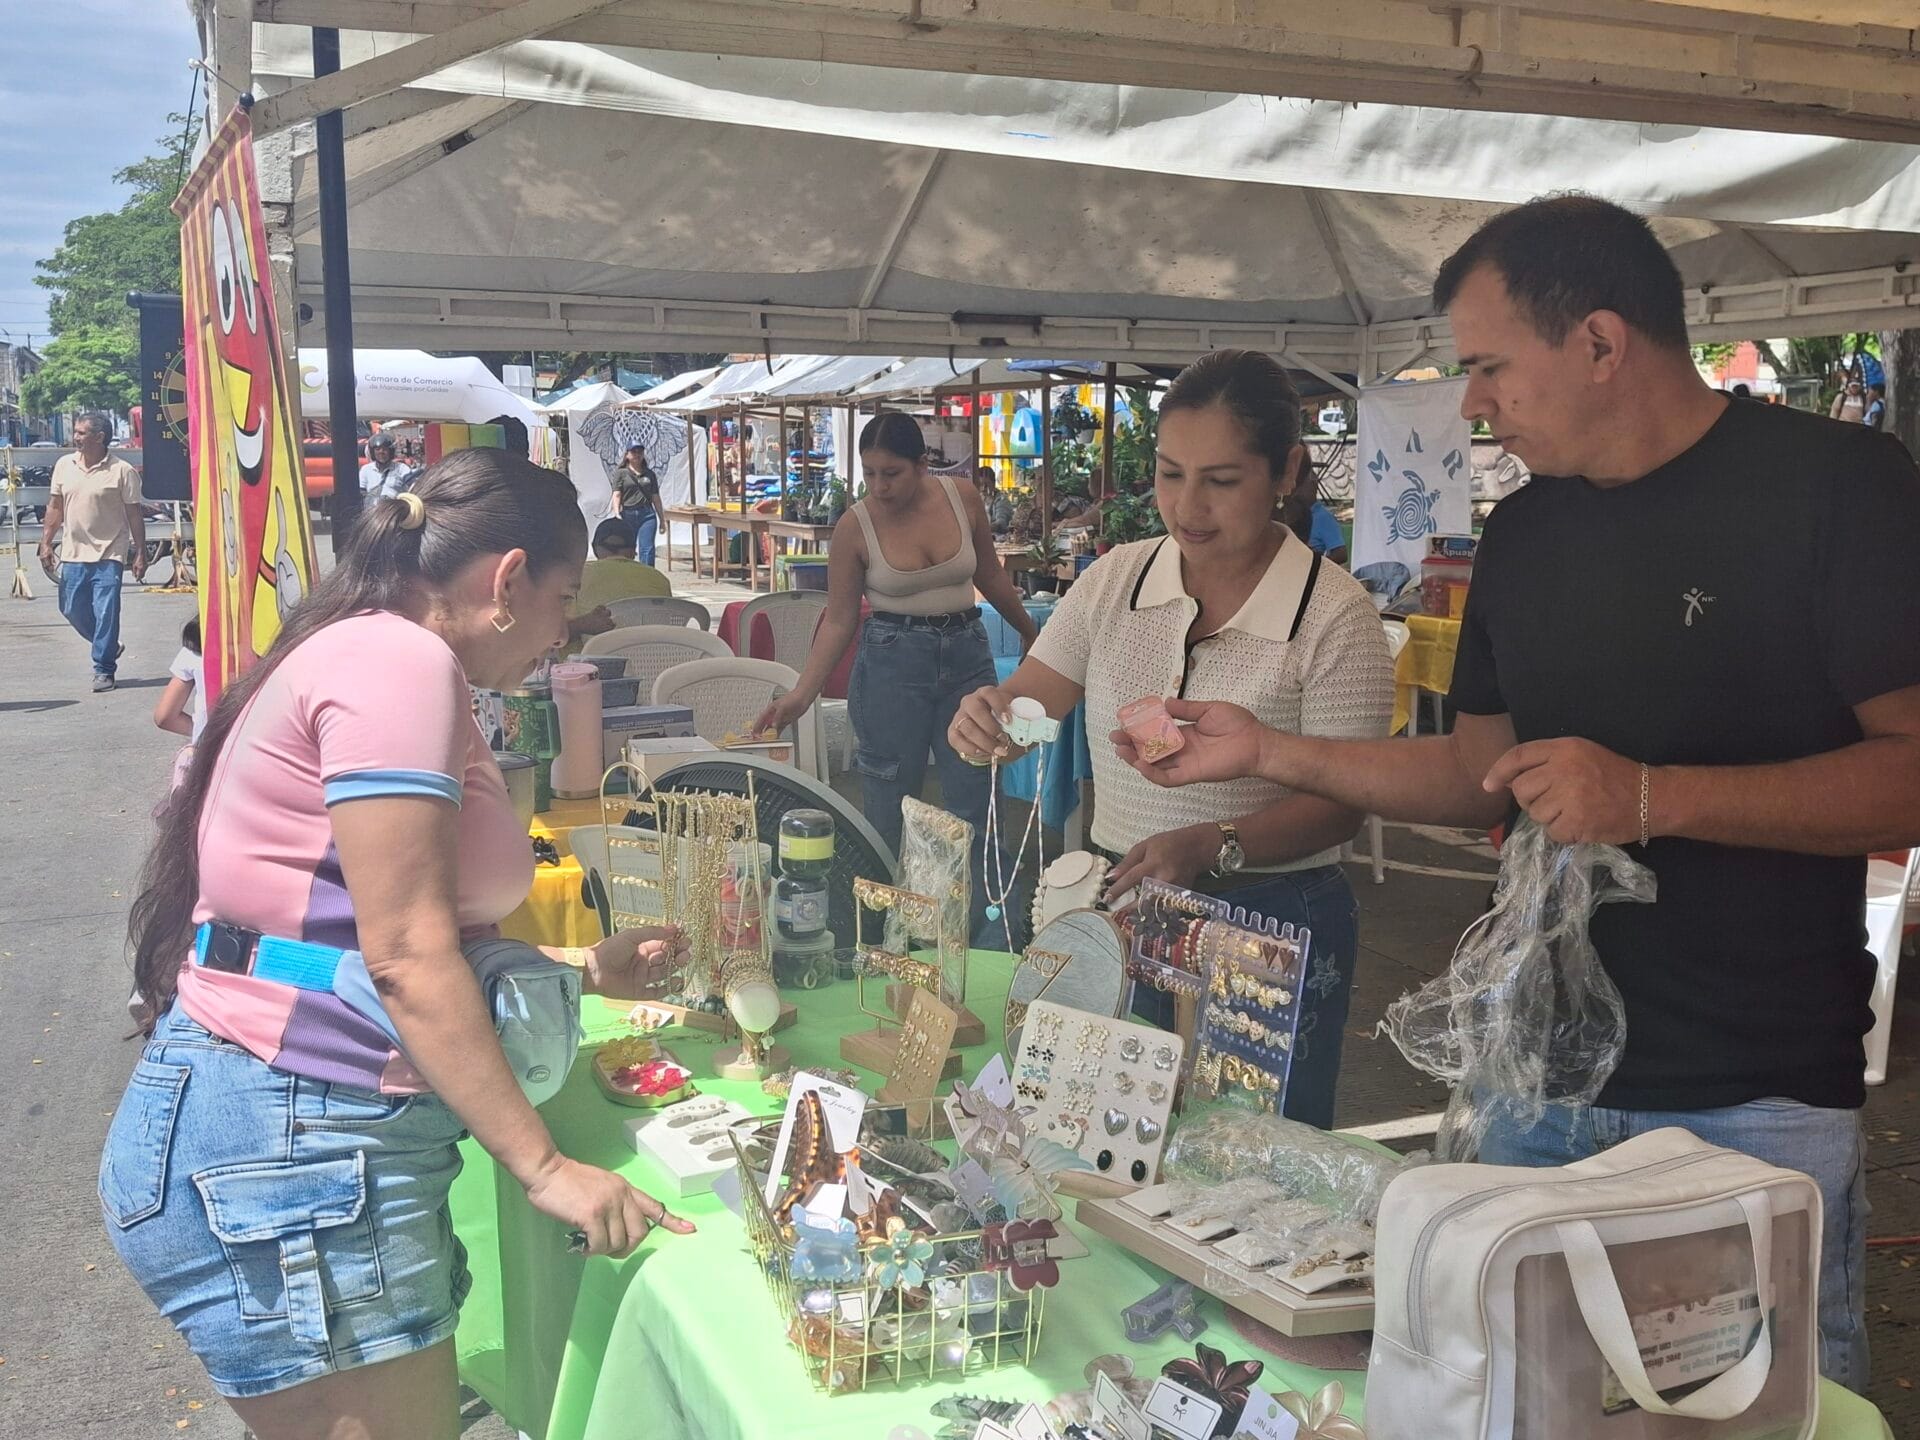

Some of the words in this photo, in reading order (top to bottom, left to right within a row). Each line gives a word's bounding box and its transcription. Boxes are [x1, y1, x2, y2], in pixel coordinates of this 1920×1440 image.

[153, 371, 162, 380] 14
[401, 376, 411, 384] de
[413, 377, 453, 386] Comercio
[151, 392, 159, 400] 11
